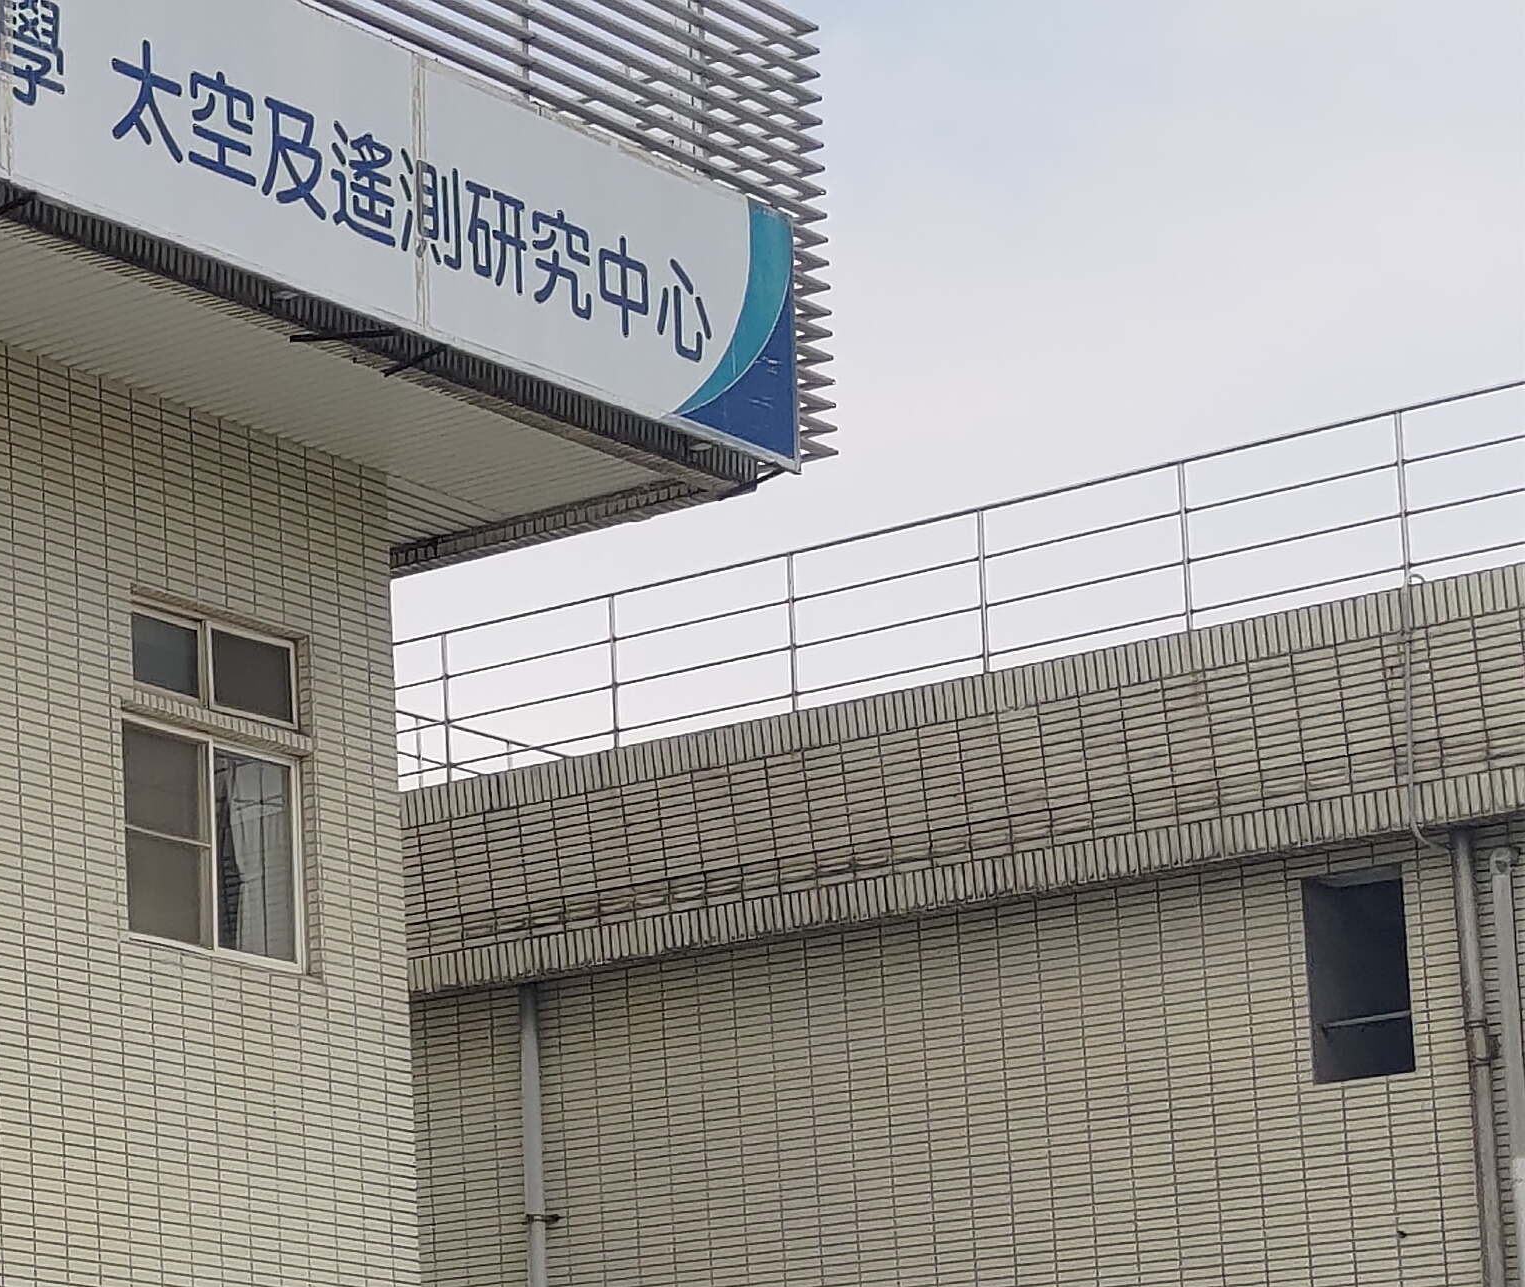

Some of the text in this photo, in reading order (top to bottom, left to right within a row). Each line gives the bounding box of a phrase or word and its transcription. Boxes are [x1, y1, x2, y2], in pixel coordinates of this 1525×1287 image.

[111, 38, 713, 363] 太空及遙測研究中心
